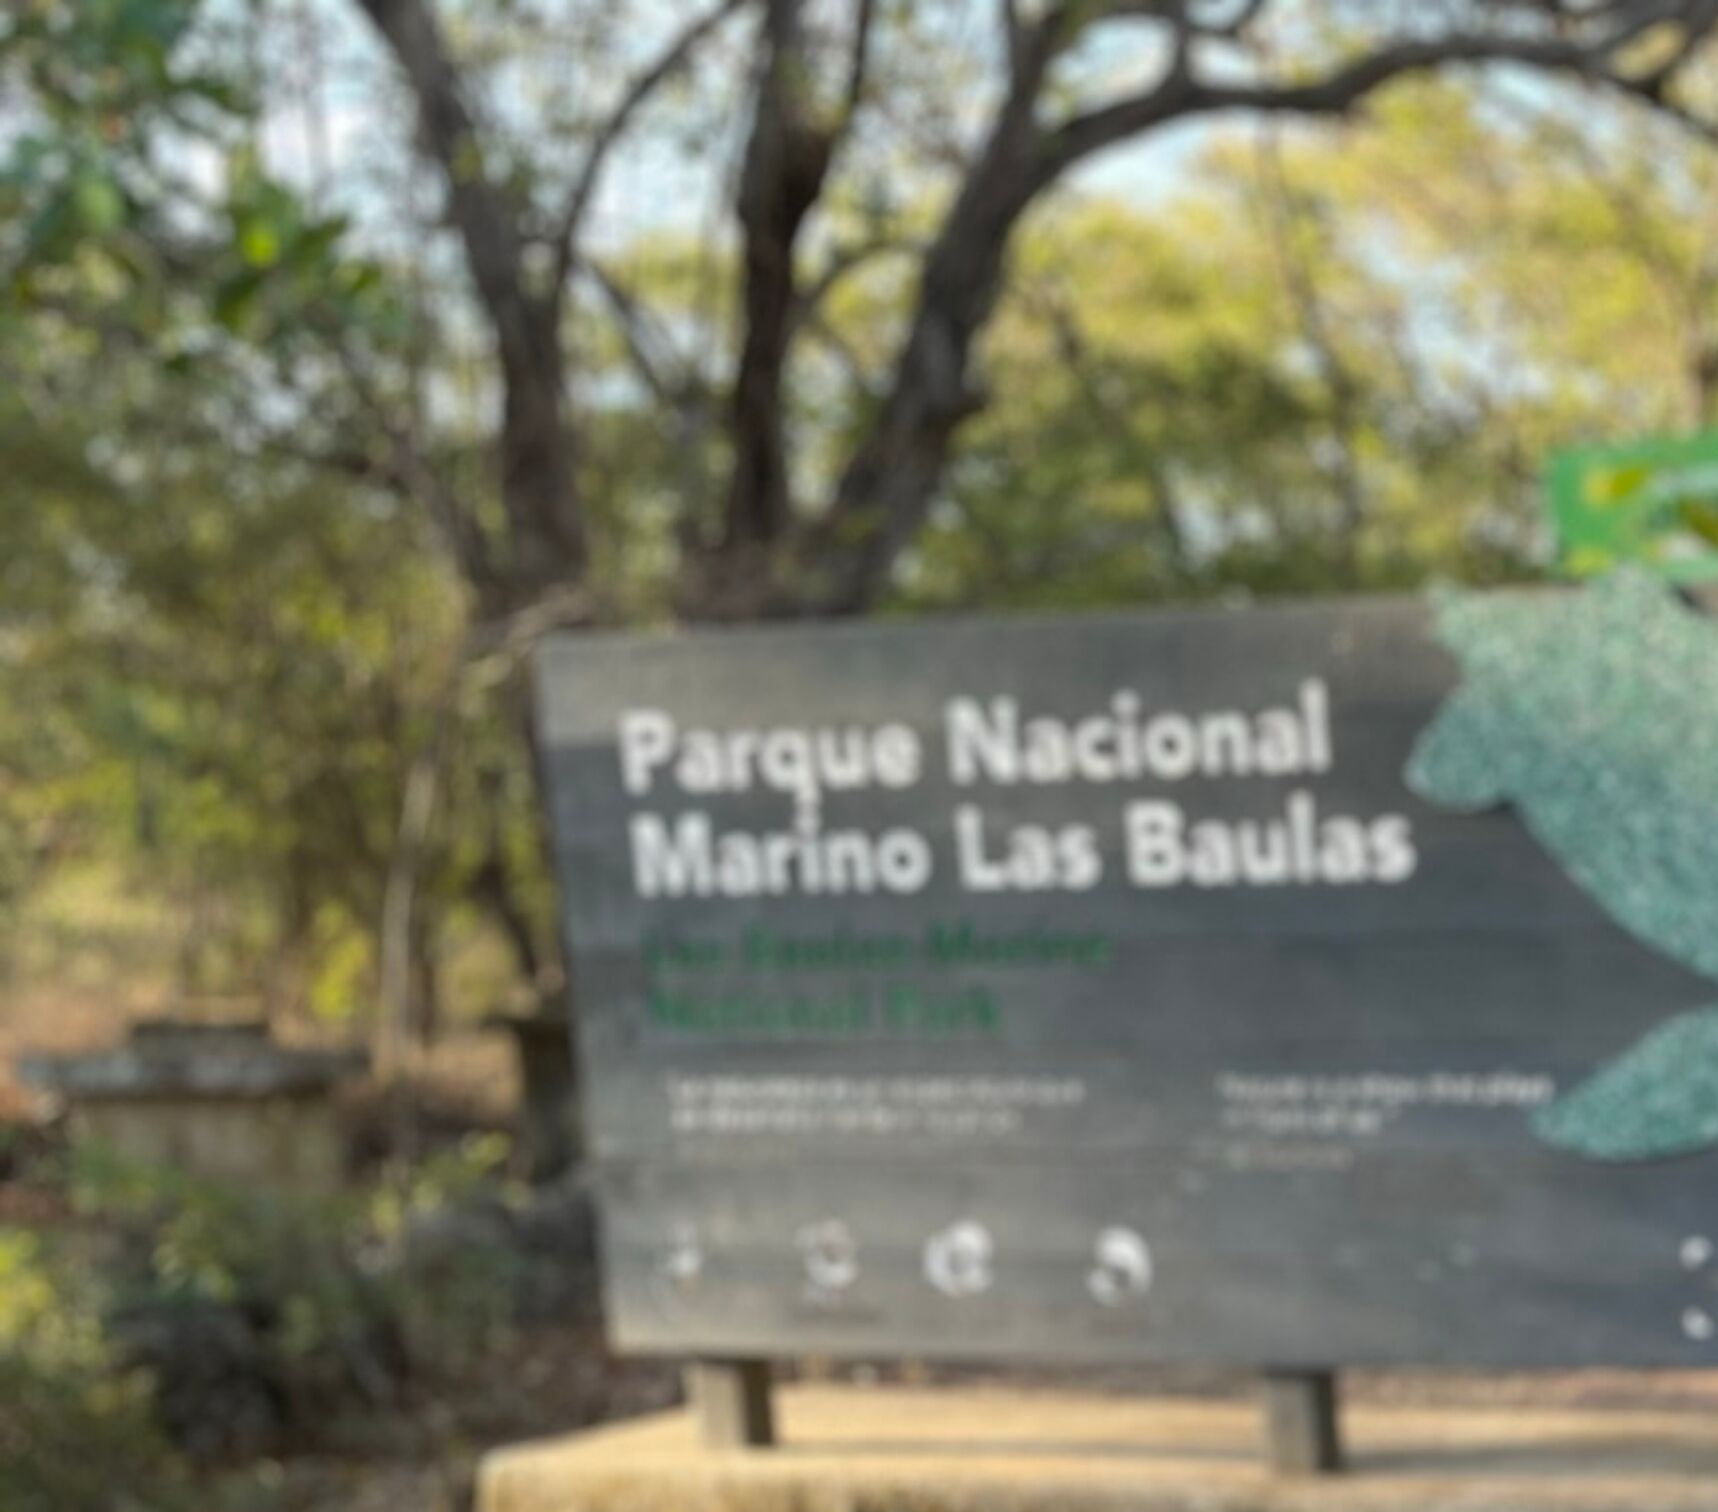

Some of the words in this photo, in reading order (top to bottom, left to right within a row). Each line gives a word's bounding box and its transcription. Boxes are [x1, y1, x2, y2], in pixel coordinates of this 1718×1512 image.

[620, 708, 922, 804] Parque
[942, 678, 1331, 786] Nacional
[628, 810, 932, 898] Marino
[954, 804, 1104, 892] Las
[1122, 791, 1418, 889] Baulas
